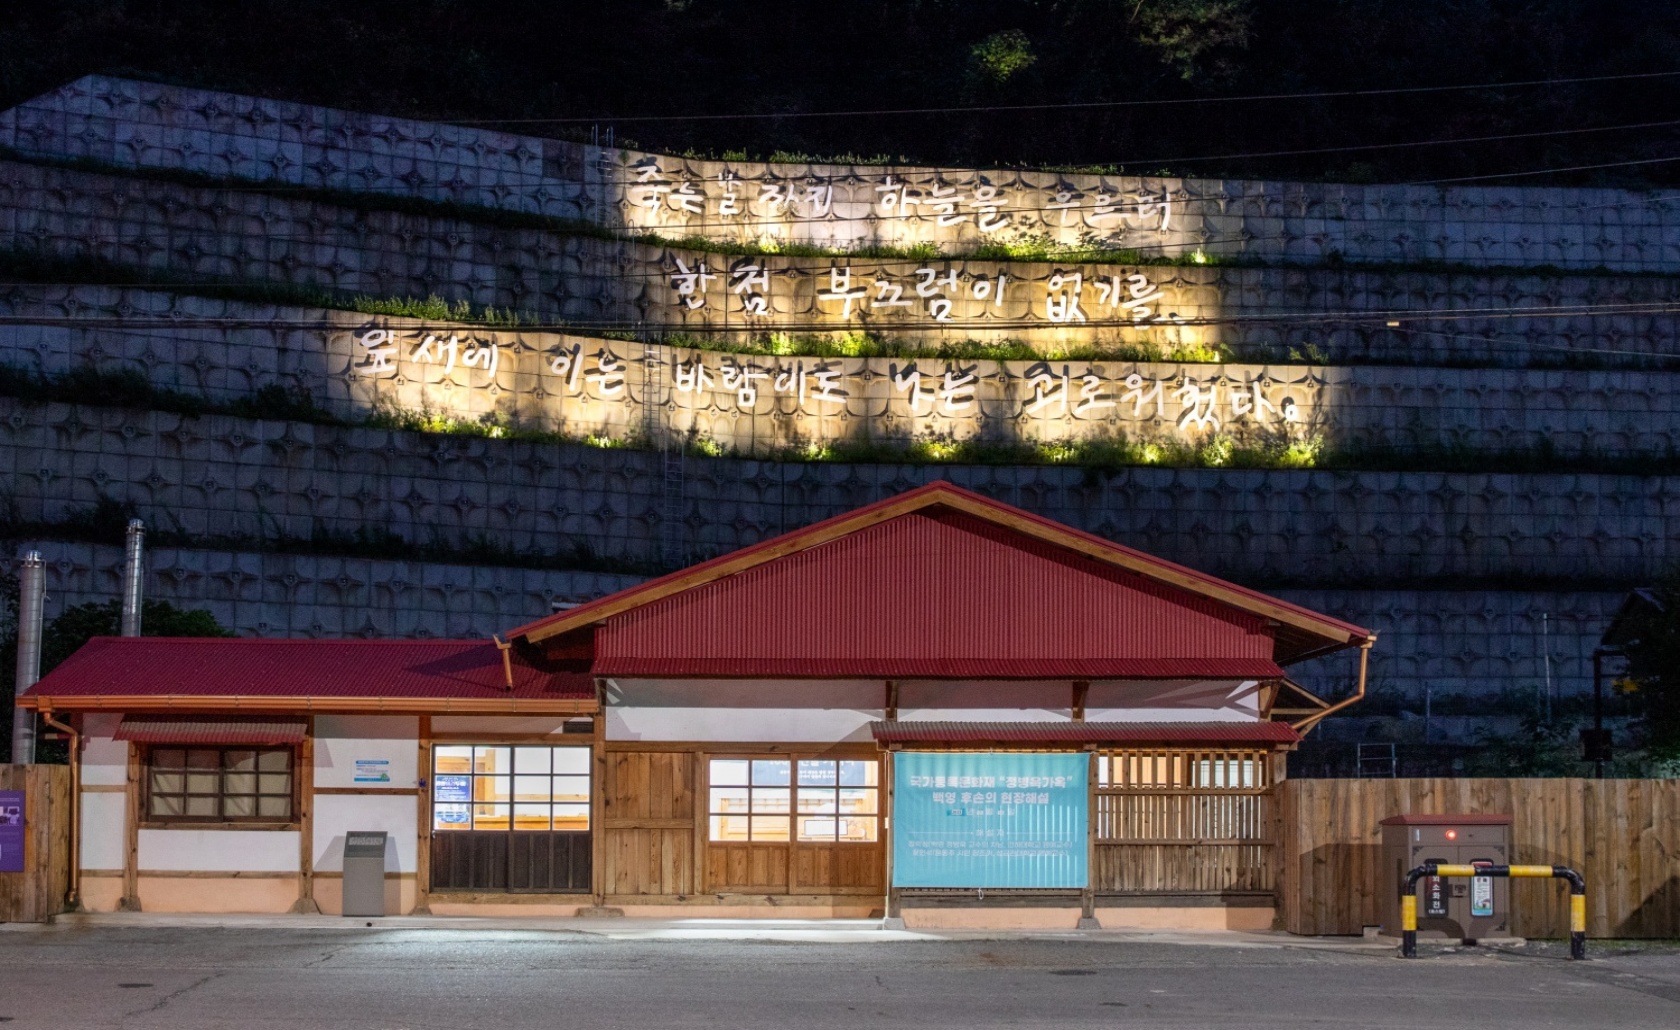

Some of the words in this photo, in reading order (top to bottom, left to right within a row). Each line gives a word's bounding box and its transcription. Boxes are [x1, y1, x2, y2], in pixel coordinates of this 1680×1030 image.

[875, 175, 1008, 232] 하늘을
[818, 266, 1006, 323] 부끄럼이
[360, 329, 499, 379] 잎새에
[550, 345, 624, 396] 이는
[675, 361, 850, 407] 바람에도
[895, 370, 976, 412] 나는
[910, 775, 996, 789] 국가등록문화재
[932, 791, 957, 805] 백영
[960, 791, 997, 805] 후손의
[1001, 791, 1049, 805] 현장해설
